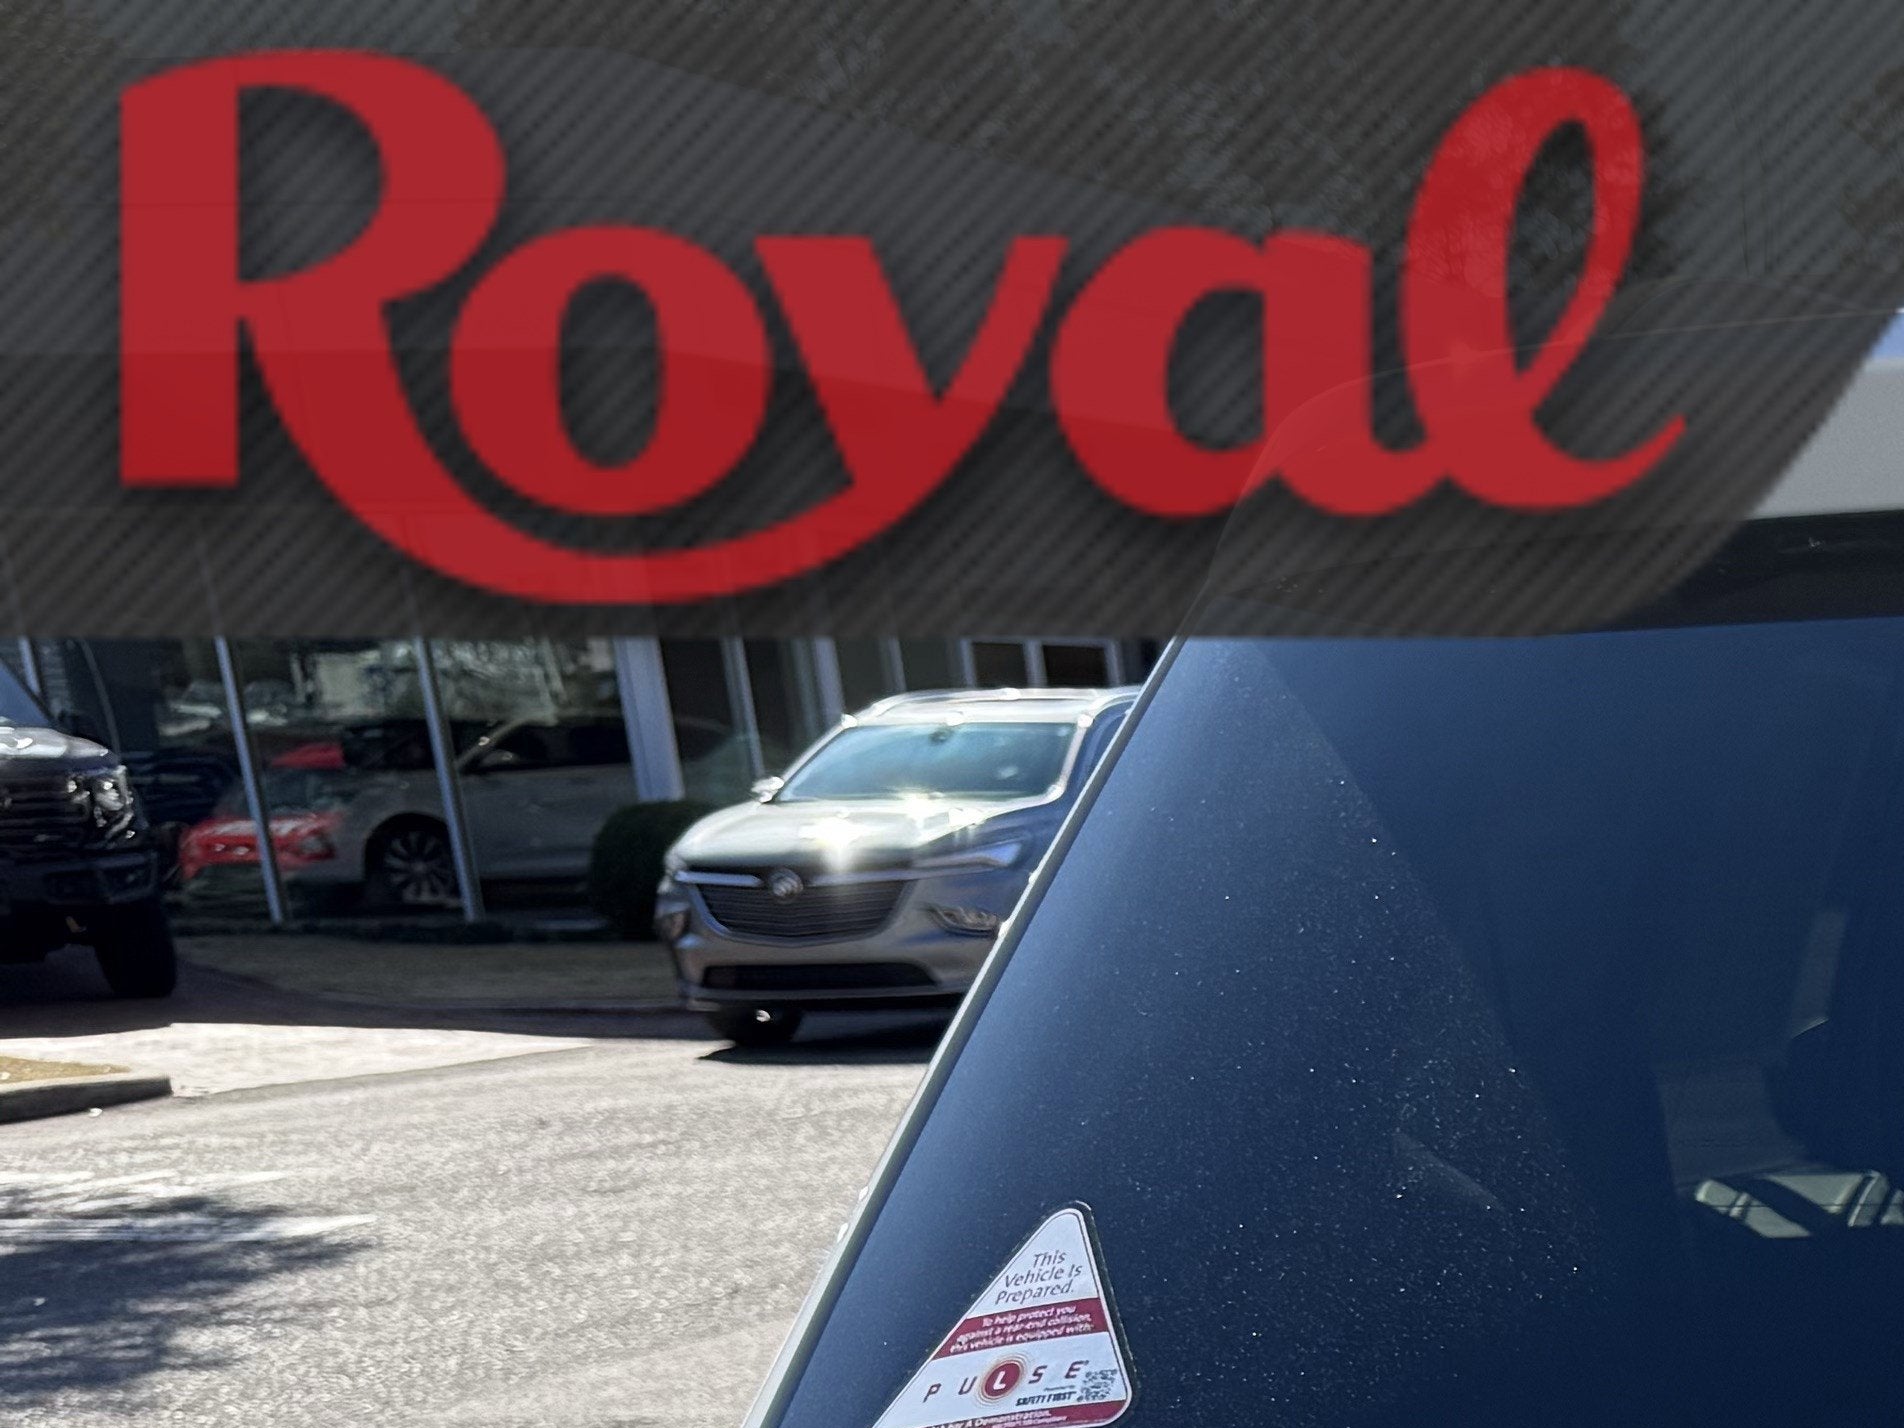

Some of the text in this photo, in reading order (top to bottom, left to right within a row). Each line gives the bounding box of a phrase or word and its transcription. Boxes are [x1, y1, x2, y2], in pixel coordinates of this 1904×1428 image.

[1033, 1249, 1067, 1268] This
[1005, 1263, 1083, 1288] Vehicle Is
[995, 1279, 1074, 1305] Prepared.
